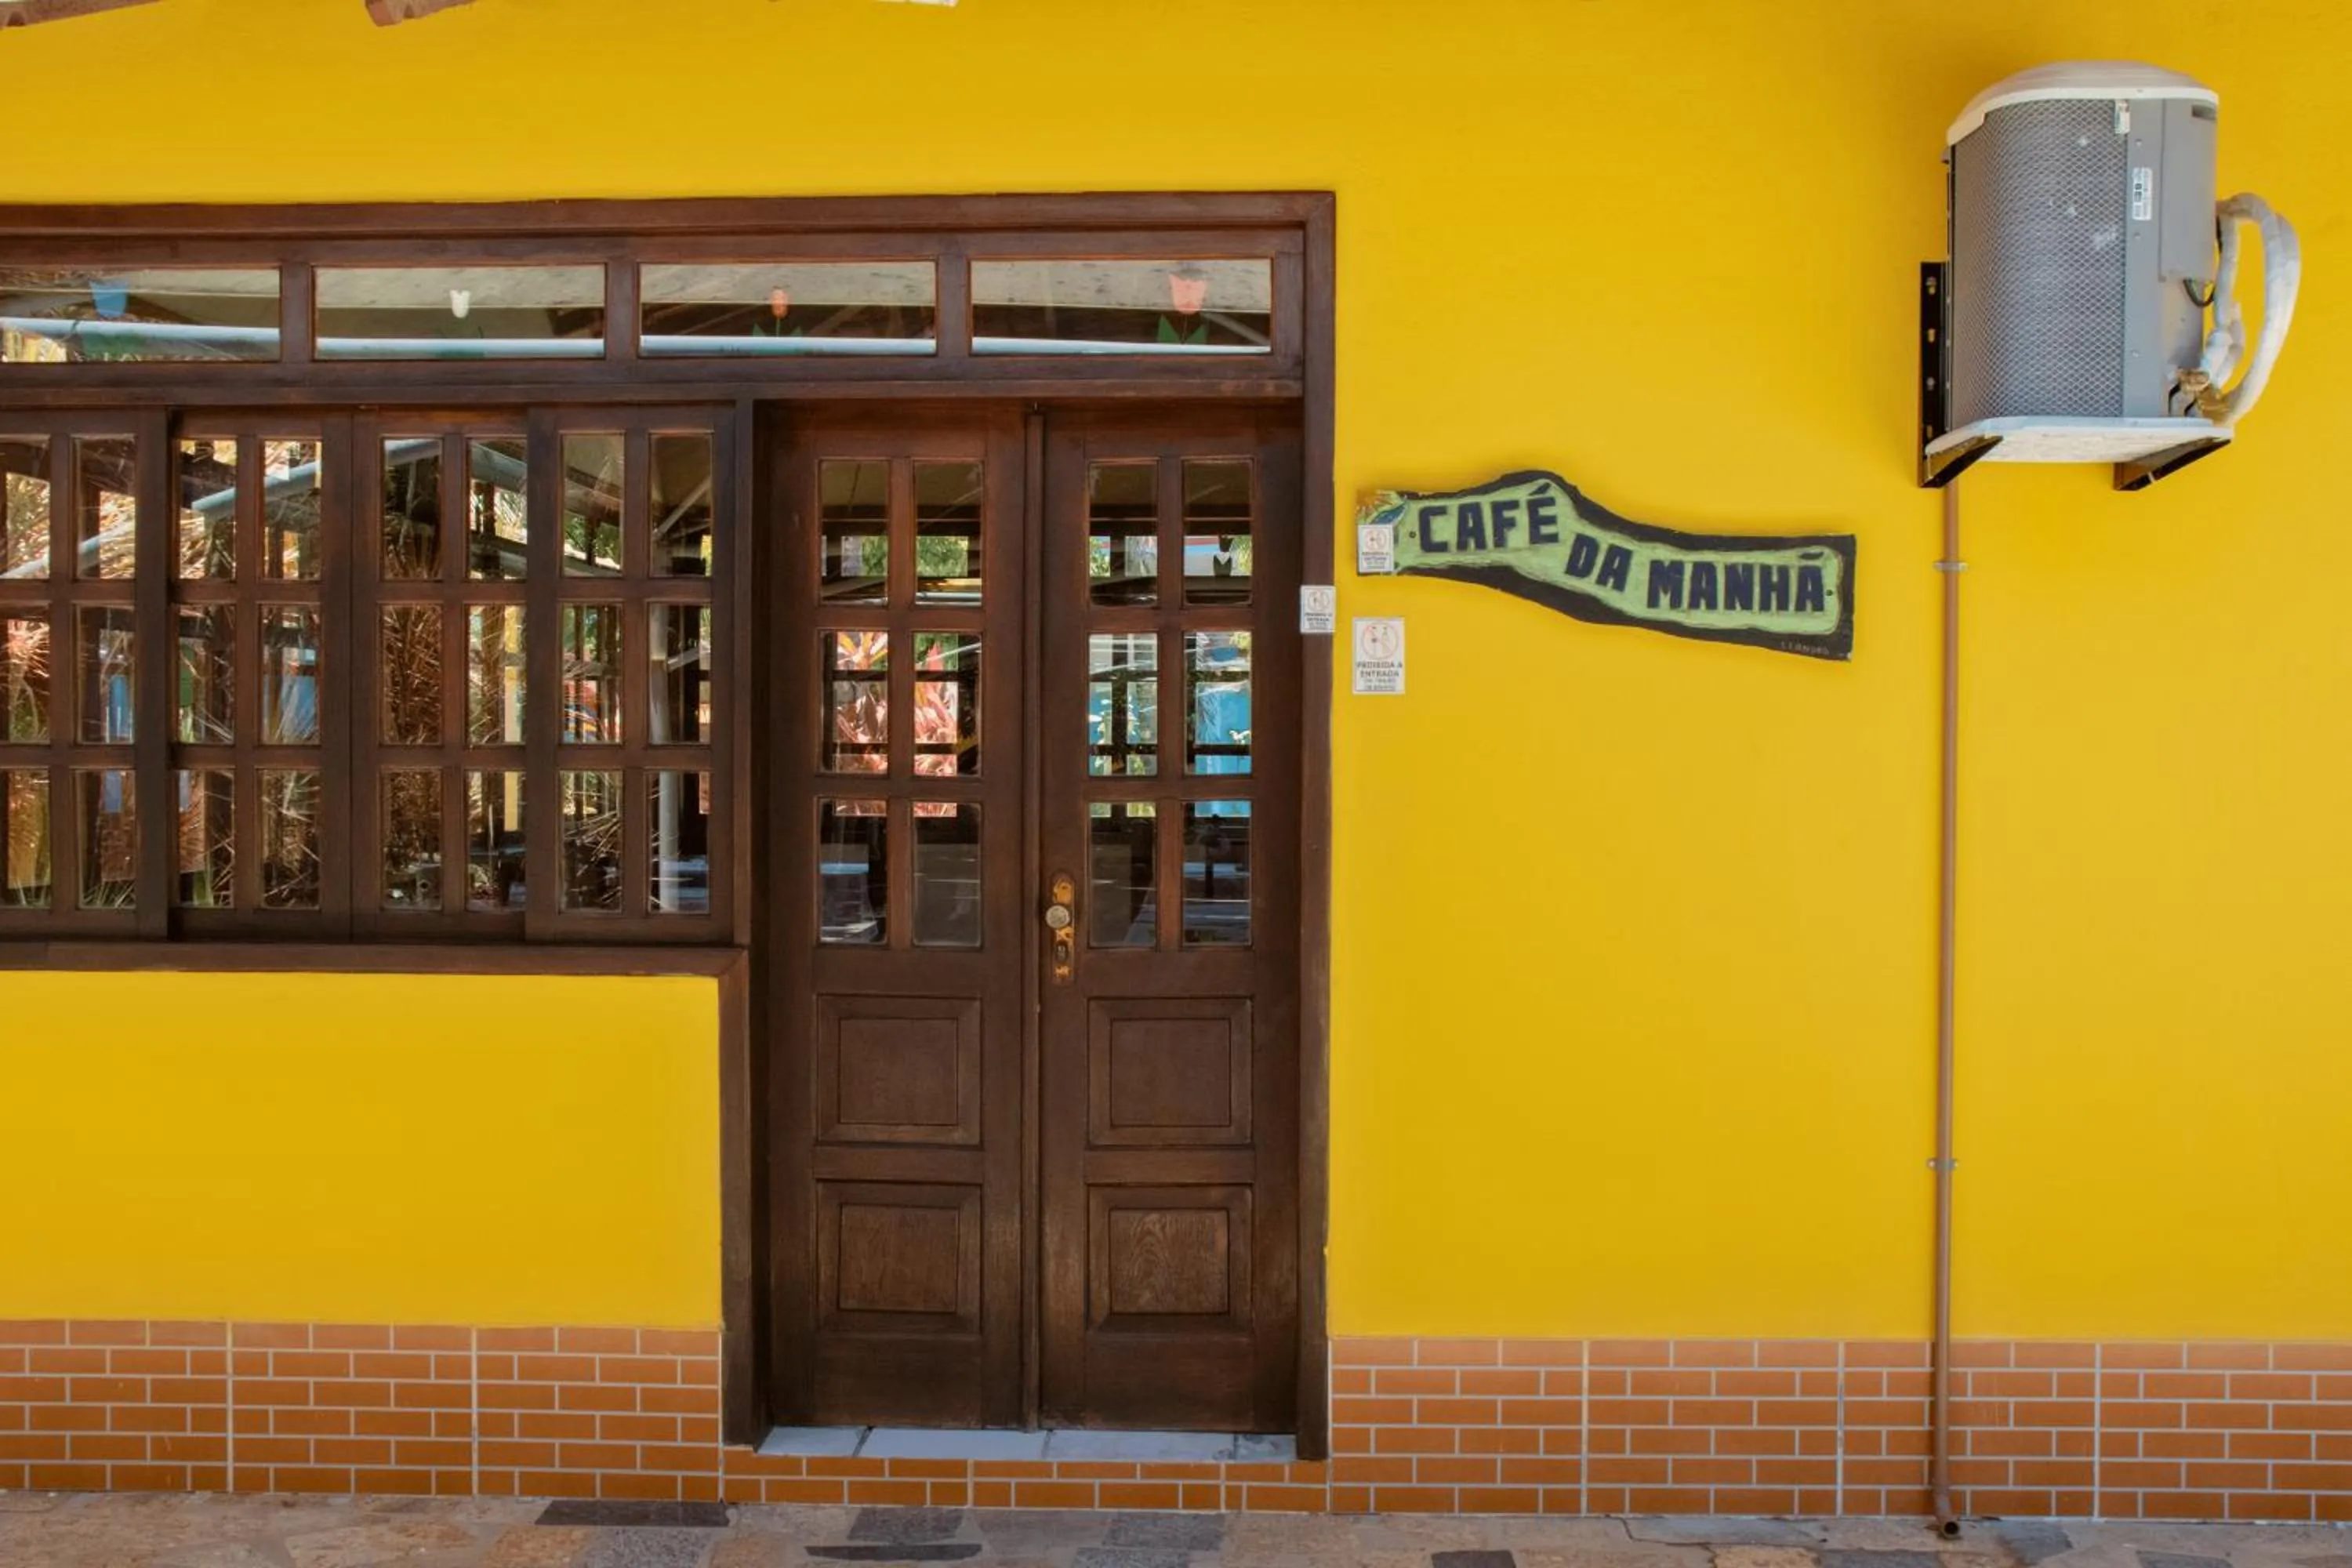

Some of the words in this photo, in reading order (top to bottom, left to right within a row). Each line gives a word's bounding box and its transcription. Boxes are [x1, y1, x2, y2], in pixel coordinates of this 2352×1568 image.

[1418, 482, 1559, 553] CAFÉ
[1565, 532, 1633, 593] DA
[1647, 551, 1825, 612] MANHÃ
